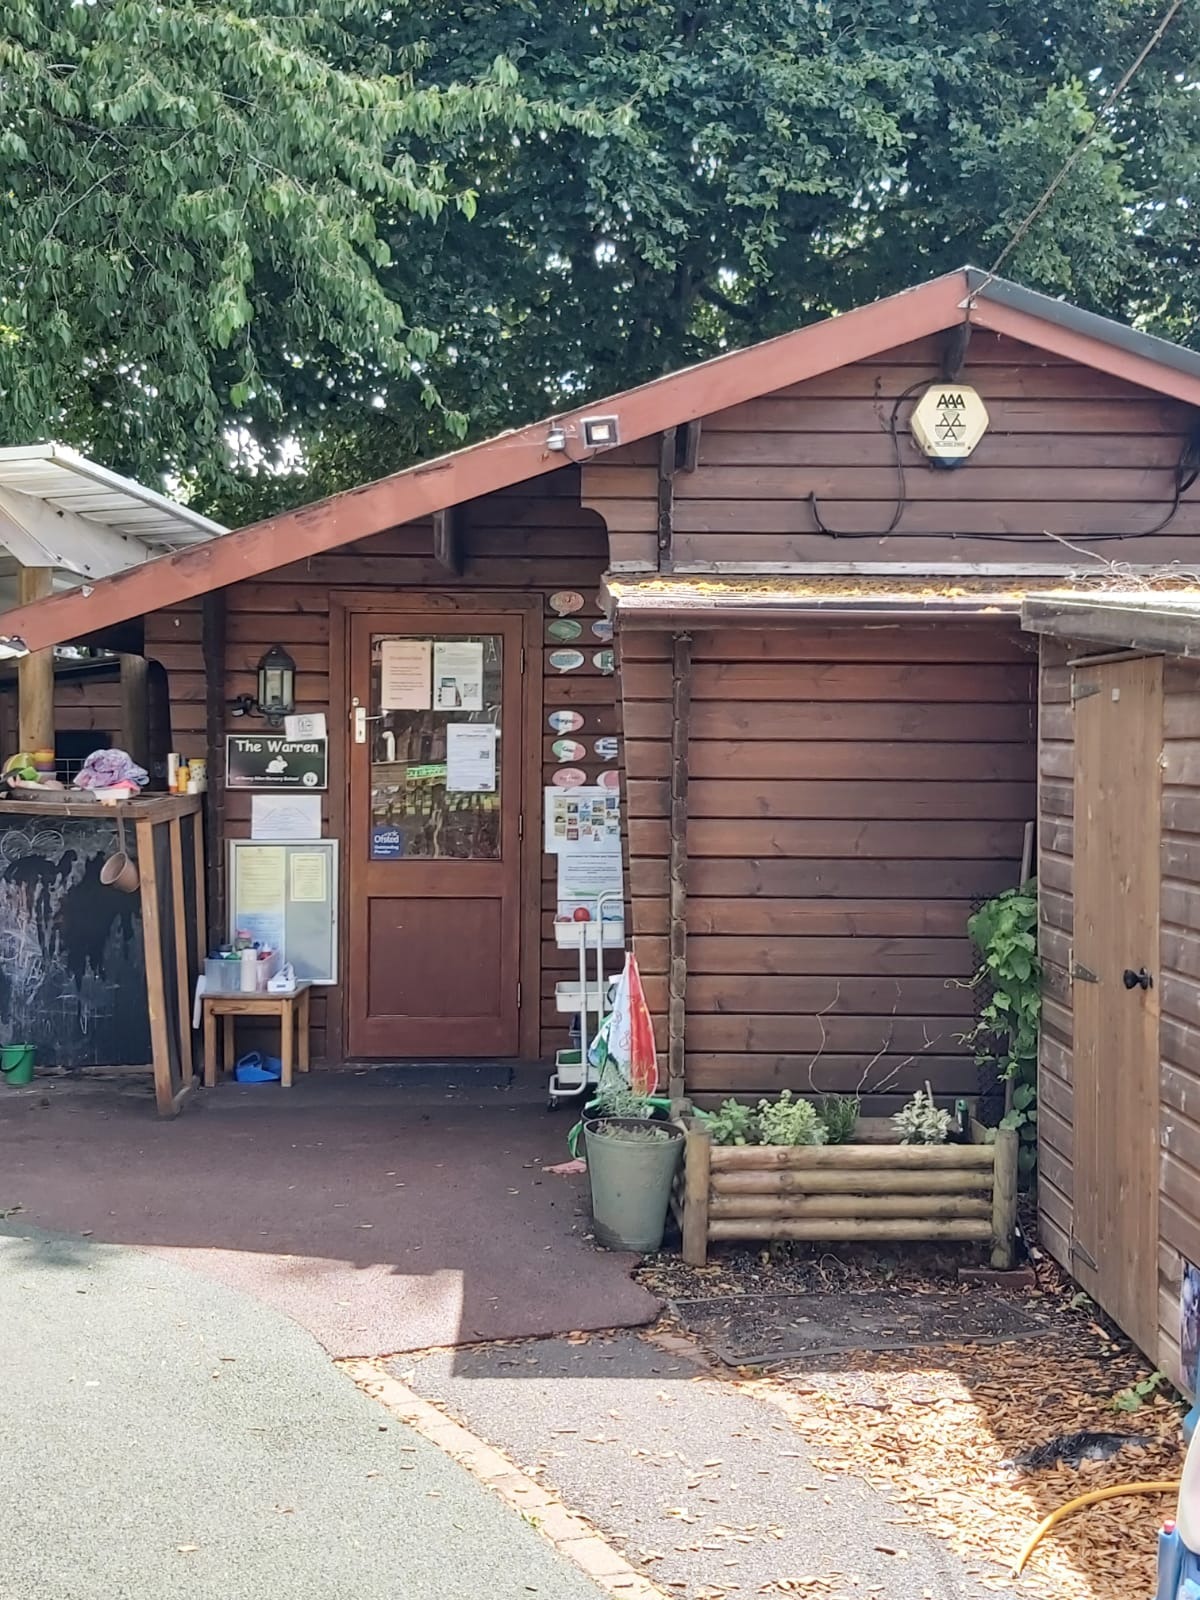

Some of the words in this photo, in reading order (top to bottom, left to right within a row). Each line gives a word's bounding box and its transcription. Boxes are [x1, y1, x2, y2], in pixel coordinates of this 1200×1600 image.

[936, 393, 966, 409] AAA
[235, 740, 262, 752] The
[267, 740, 319, 753] Warren
[374, 834, 400, 843] Ofsted
